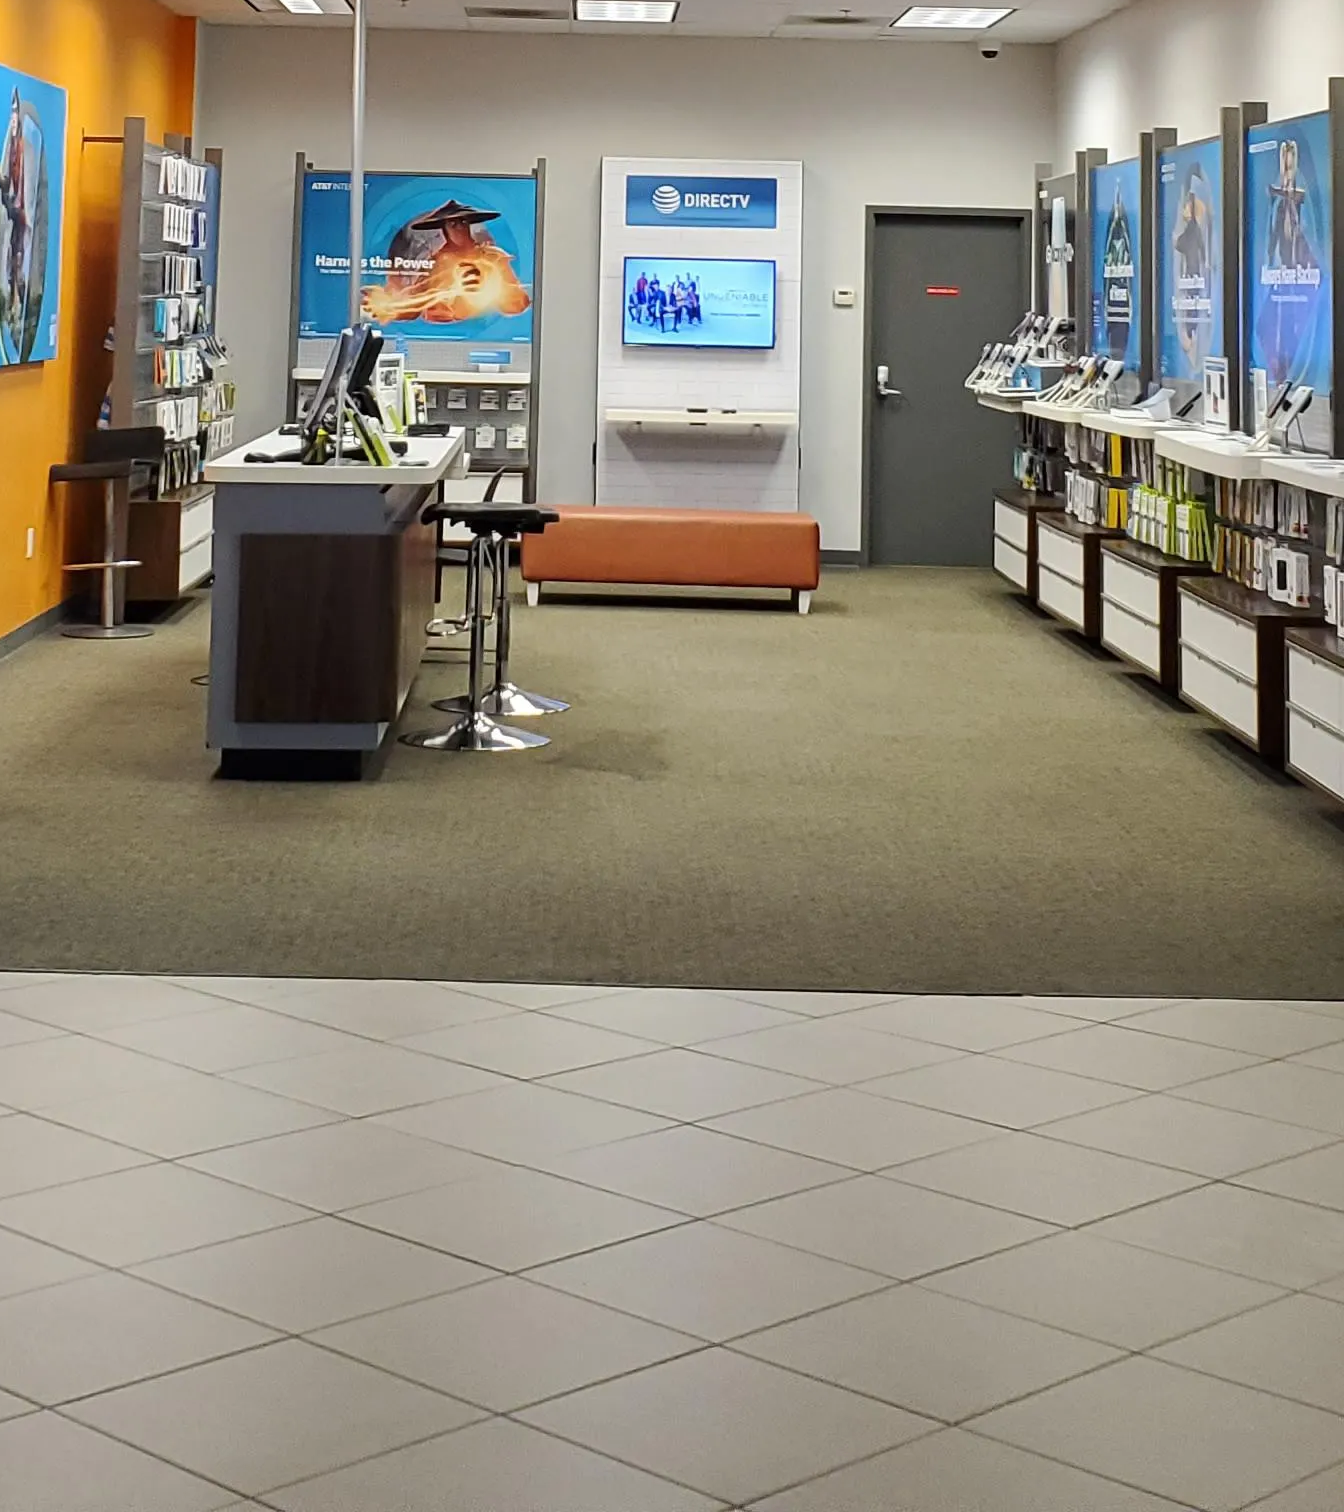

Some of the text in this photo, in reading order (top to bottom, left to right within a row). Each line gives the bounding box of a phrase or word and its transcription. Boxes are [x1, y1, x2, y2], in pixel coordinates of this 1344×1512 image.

[684, 193, 751, 209] DIRECTV
[315, 254, 436, 270] Harnes the Power
